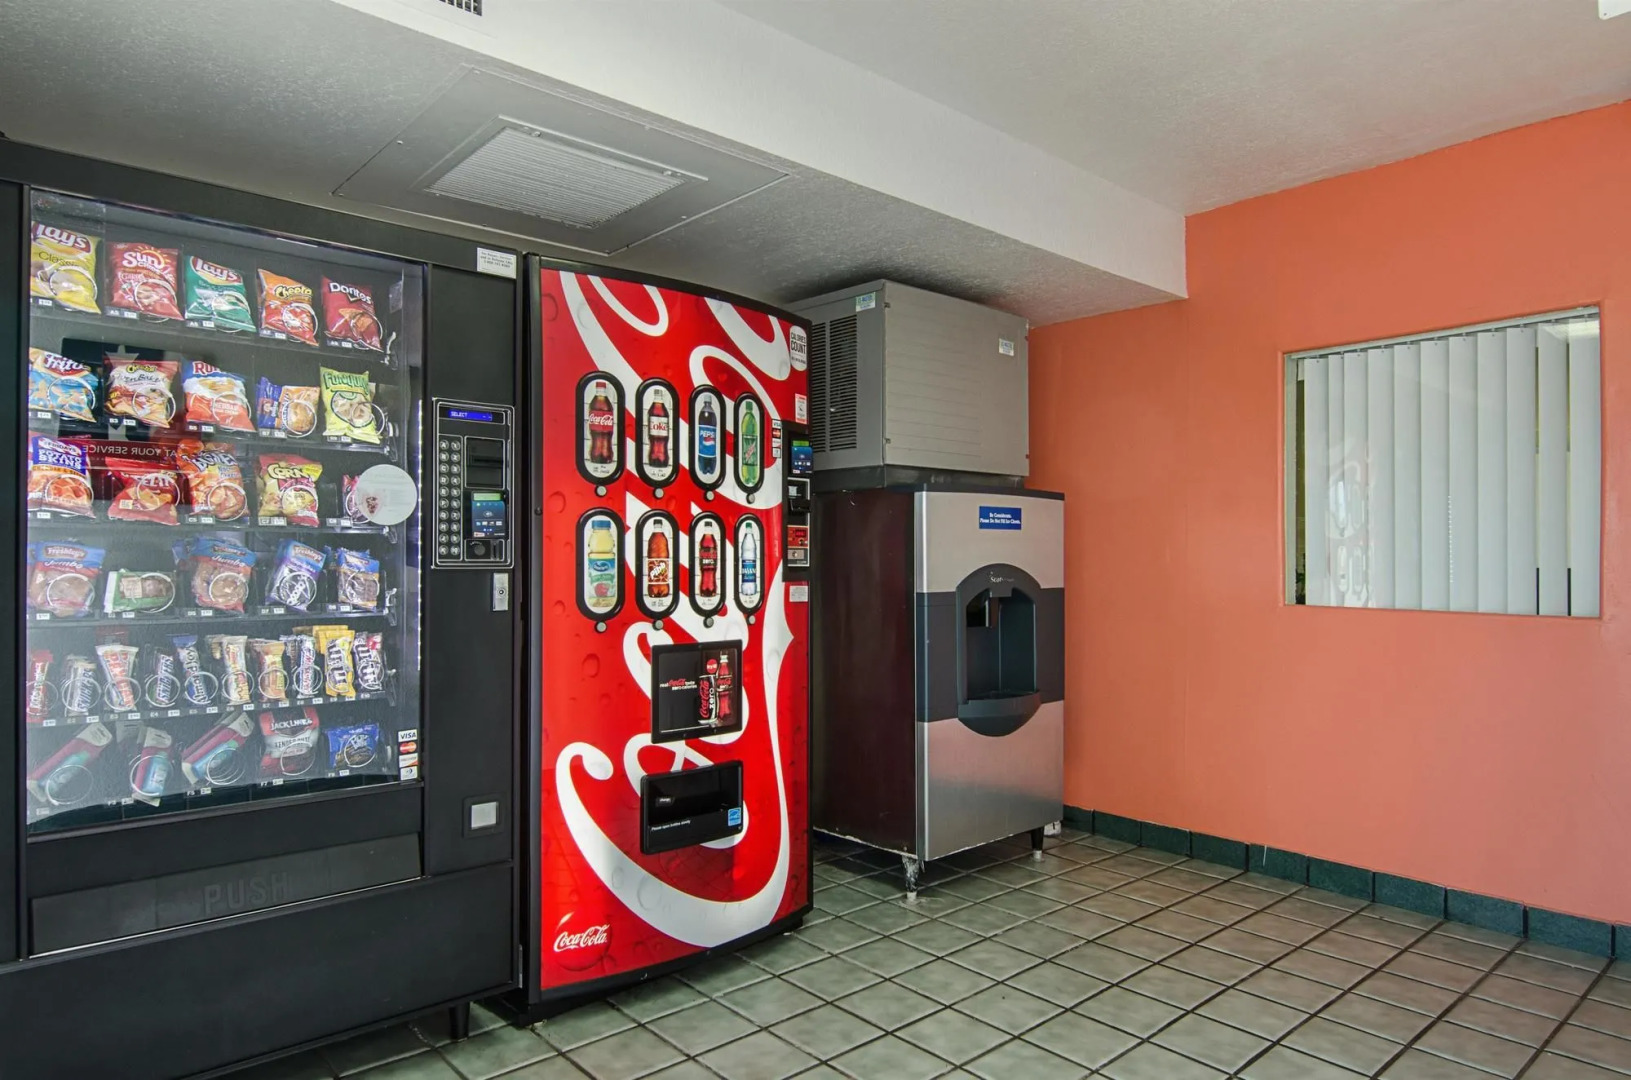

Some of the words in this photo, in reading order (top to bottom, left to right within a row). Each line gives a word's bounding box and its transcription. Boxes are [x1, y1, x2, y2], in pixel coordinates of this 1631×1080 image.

[275, 285, 312, 299] Cheeto
[330, 282, 372, 304] Doritos
[791, 341, 806, 354] COUNT
[323, 372, 369, 395] FUNYUN
[589, 413, 613, 426] Coca-Cola
[39, 449, 82, 462] POTATO
[39, 455, 81, 469] SKINS
[44, 560, 83, 568] Jumbo
[212, 556, 246, 566] Jumbo
[700, 680, 710, 718] Coca-Cola
[271, 721, 290, 731] JACK
[400, 732, 416, 740] VISA
[204, 871, 288, 916] PUSH
[553, 924, 610, 952] Coca-Cola
